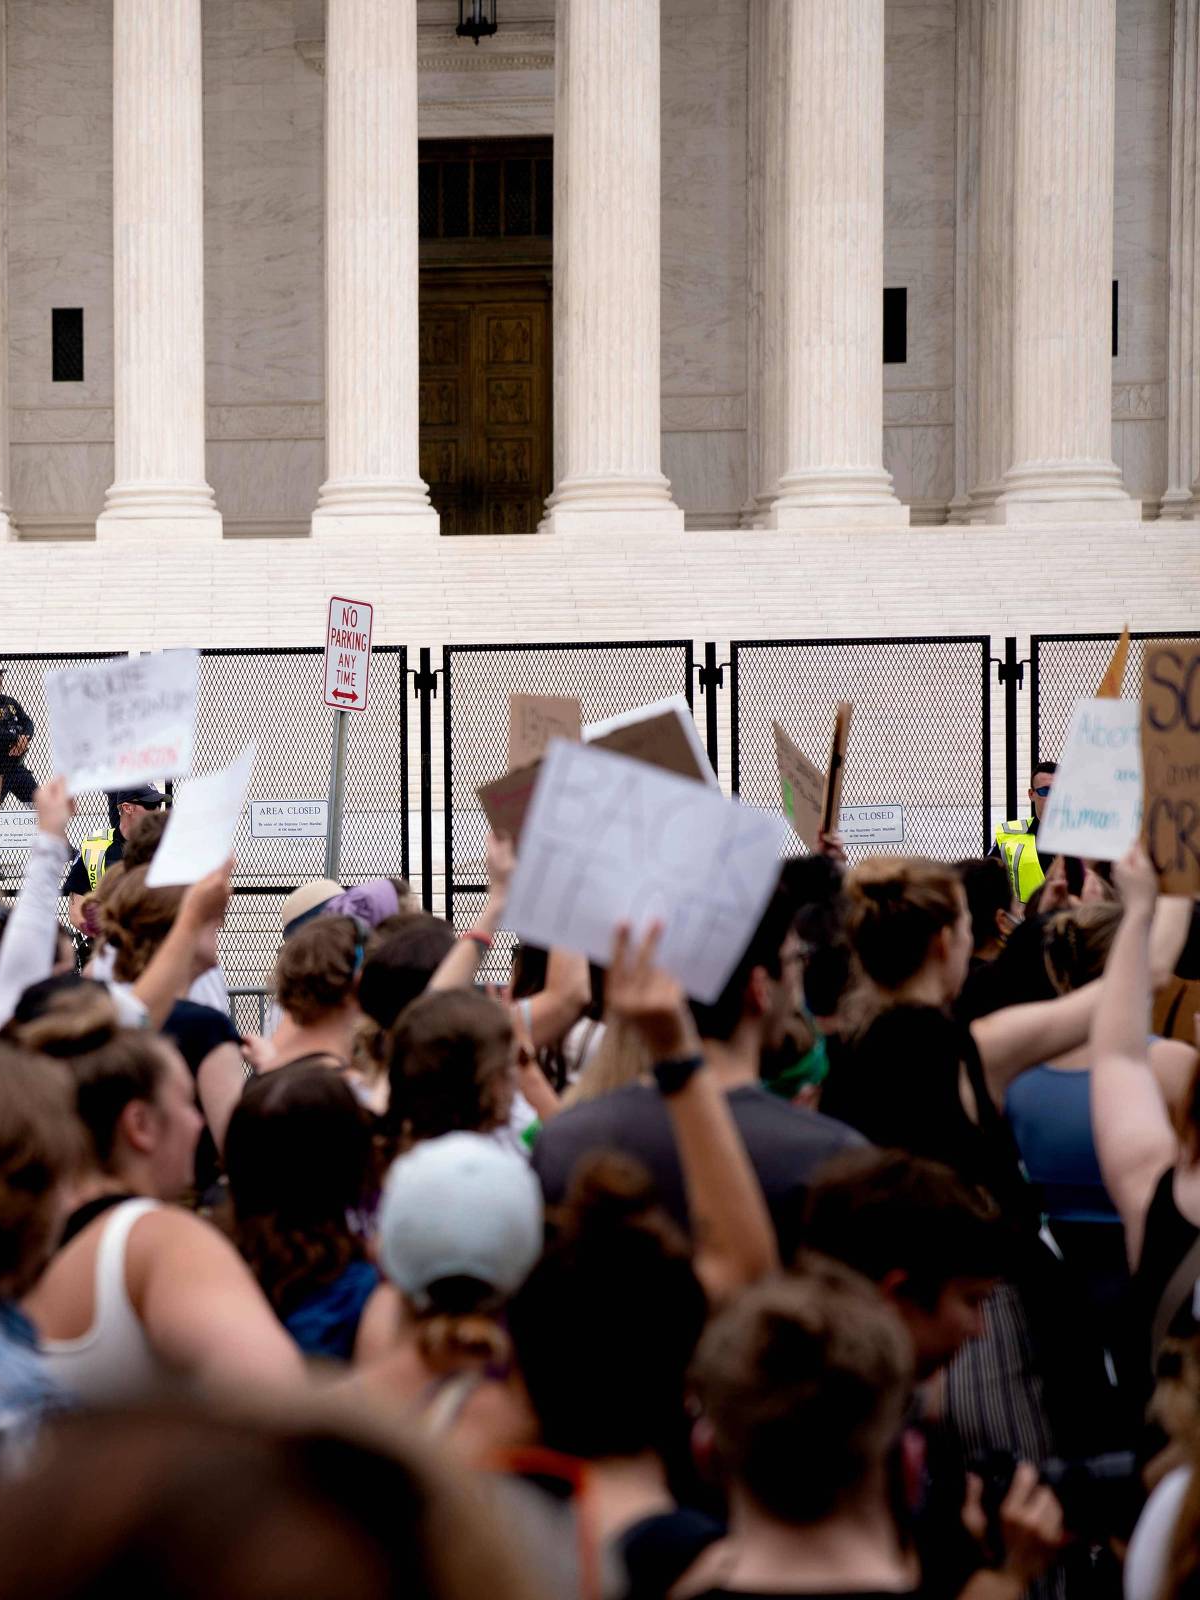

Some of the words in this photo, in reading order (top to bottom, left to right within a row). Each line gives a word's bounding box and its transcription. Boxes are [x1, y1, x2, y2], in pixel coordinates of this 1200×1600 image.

[342, 607, 358, 628] NO
[330, 627, 367, 652] PARKING
[338, 653, 357, 669] ANY
[336, 670, 357, 687] TIME
[259, 807, 284, 815] AREA
[287, 806, 321, 815] CLOSED
[859, 811, 894, 820] CLOSED
[1049, 798, 1120, 834] Human
[541, 750, 774, 914] BACK
